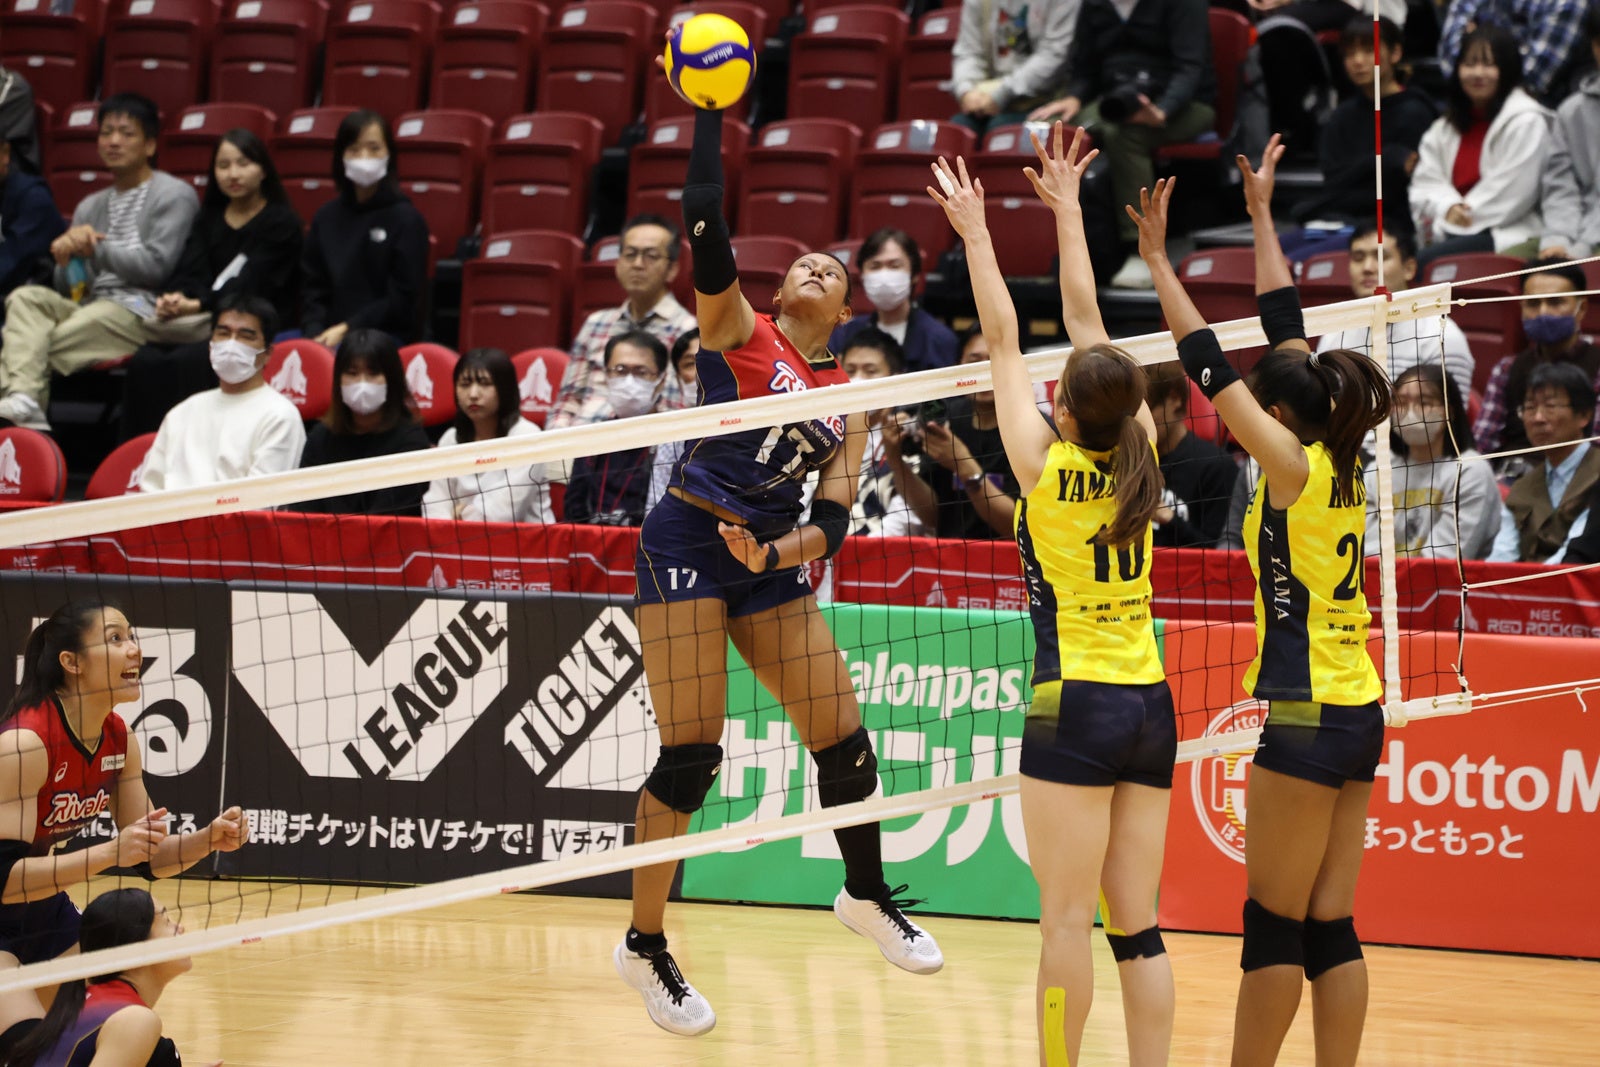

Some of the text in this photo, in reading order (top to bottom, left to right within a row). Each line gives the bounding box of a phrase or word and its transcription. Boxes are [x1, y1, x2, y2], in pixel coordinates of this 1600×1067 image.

[755, 426, 815, 474] 17
[1086, 523, 1145, 583] 10
[493, 569, 521, 580] NEC
[667, 567, 698, 590] 17
[957, 597, 990, 610] RED
[998, 587, 1026, 599] NEC
[1487, 619, 1522, 634] RED
[1530, 609, 1563, 621] NEC
[343, 600, 509, 781] LEAGUE
[838, 651, 1023, 720] alonpas
[1375, 740, 1549, 811] Hotto
